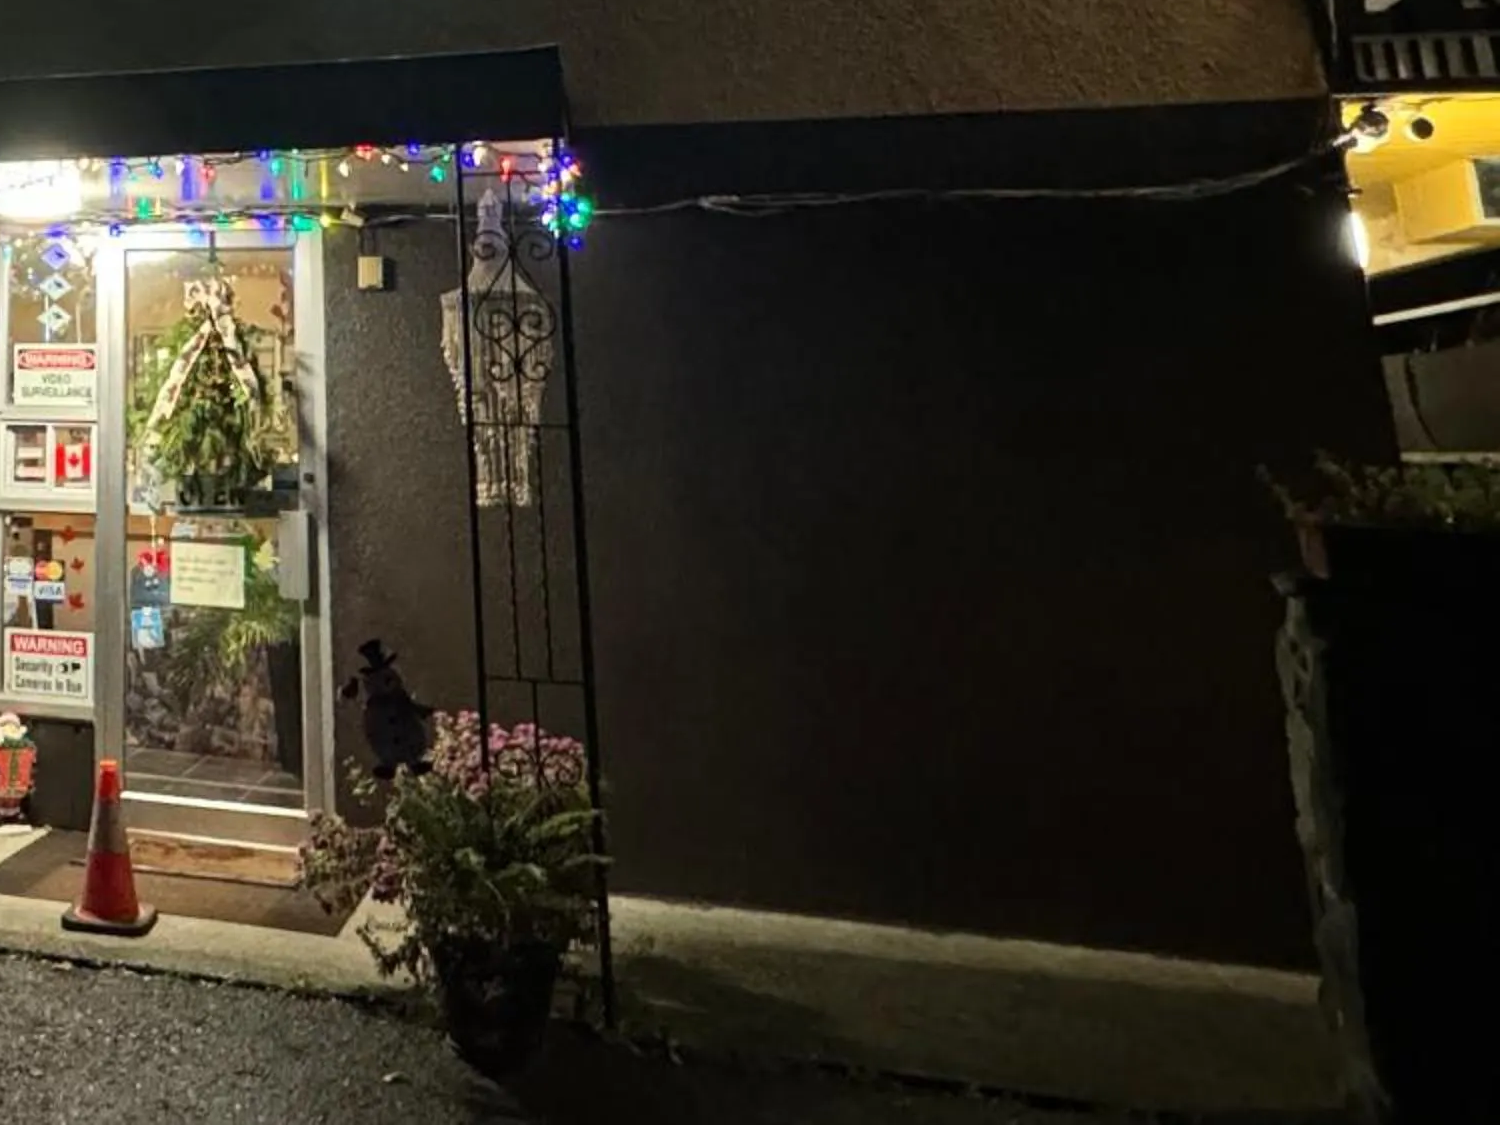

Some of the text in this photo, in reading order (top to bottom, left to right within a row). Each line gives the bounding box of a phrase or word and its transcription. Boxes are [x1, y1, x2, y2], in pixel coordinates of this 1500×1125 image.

[38, 586, 62, 596] VISA
[13, 635, 85, 655] WARNING
[14, 657, 53, 676] Security
